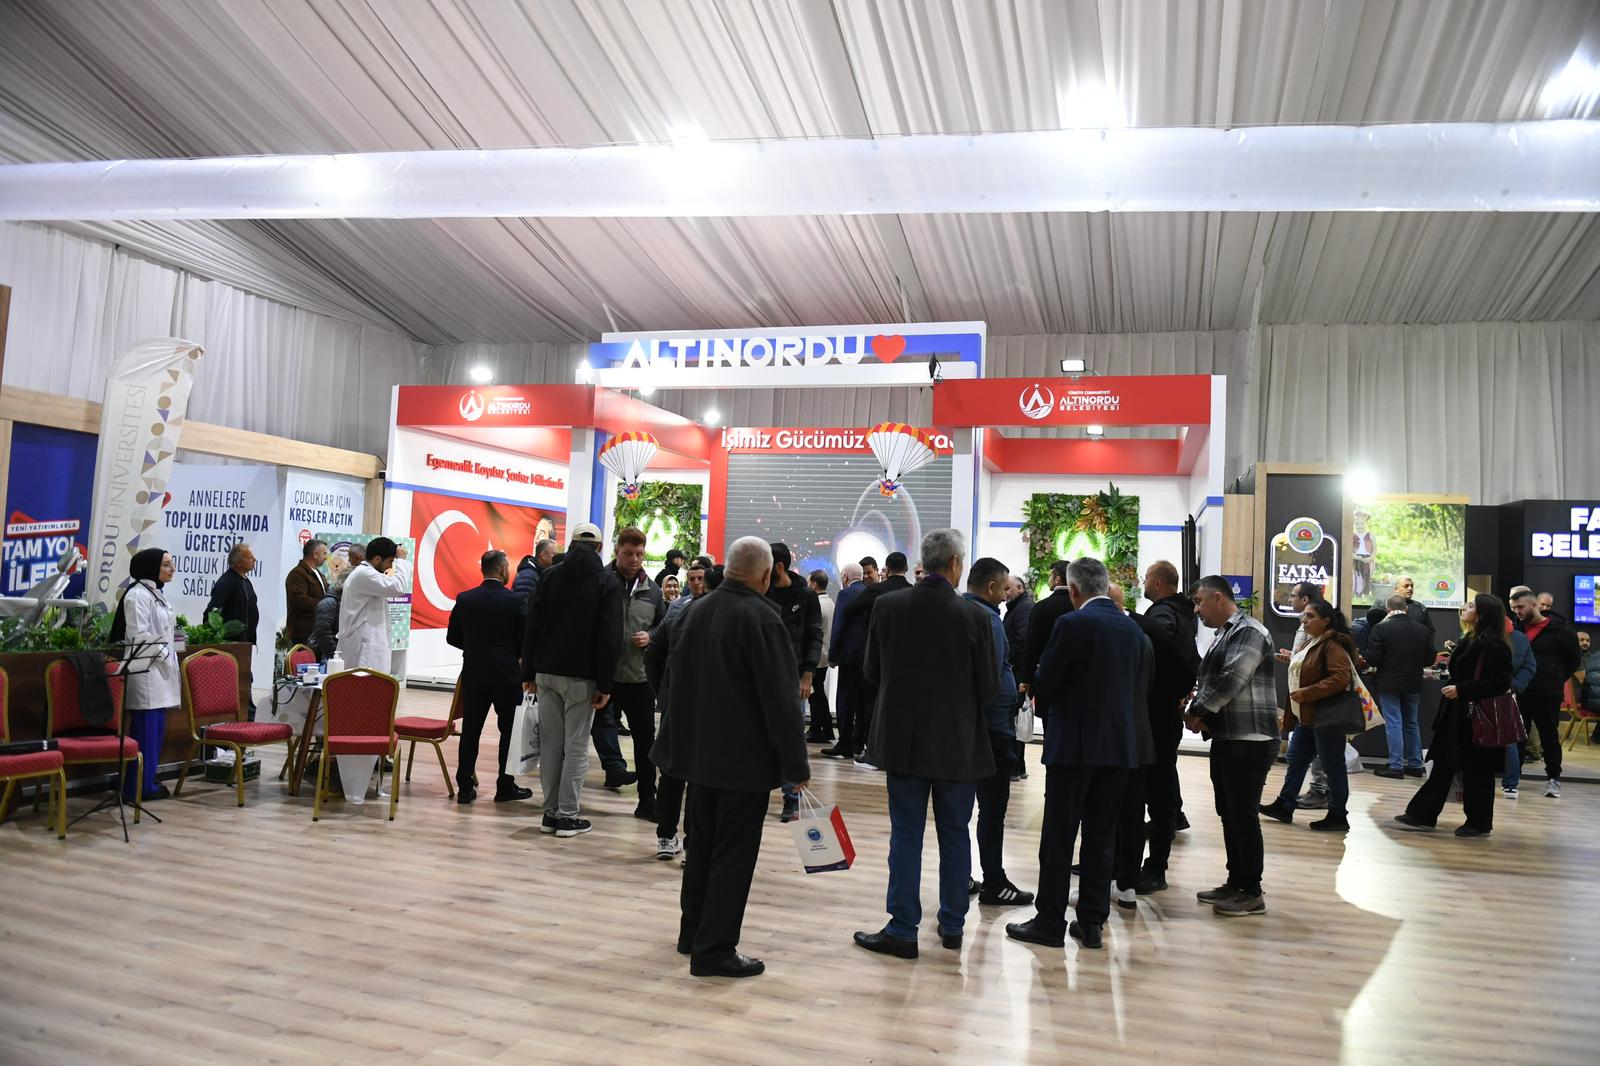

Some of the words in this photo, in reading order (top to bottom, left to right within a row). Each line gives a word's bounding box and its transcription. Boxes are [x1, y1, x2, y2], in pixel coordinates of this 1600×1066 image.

[621, 335, 866, 369] ALTINORDU
[1059, 396, 1120, 405] ALTINORDU
[721, 426, 771, 451] İşimiz
[775, 429, 865, 449] Gücümüz
[188, 489, 246, 508] ANNELERE
[294, 490, 335, 507] ÇOCUKLAR
[335, 494, 352, 510] İÇİN
[11, 524, 28, 533] YENİ
[29, 521, 77, 531] YATIRIMLARLA
[165, 511, 202, 529] TOPLU
[205, 513, 269, 534] ULAŞIMDA
[289, 507, 328, 525] KREŞLER
[328, 512, 354, 527] AÇTIK
[3, 538, 43, 560] TAM
[98, 524, 120, 594] ORDU
[1278, 564, 1328, 578] FATSA
